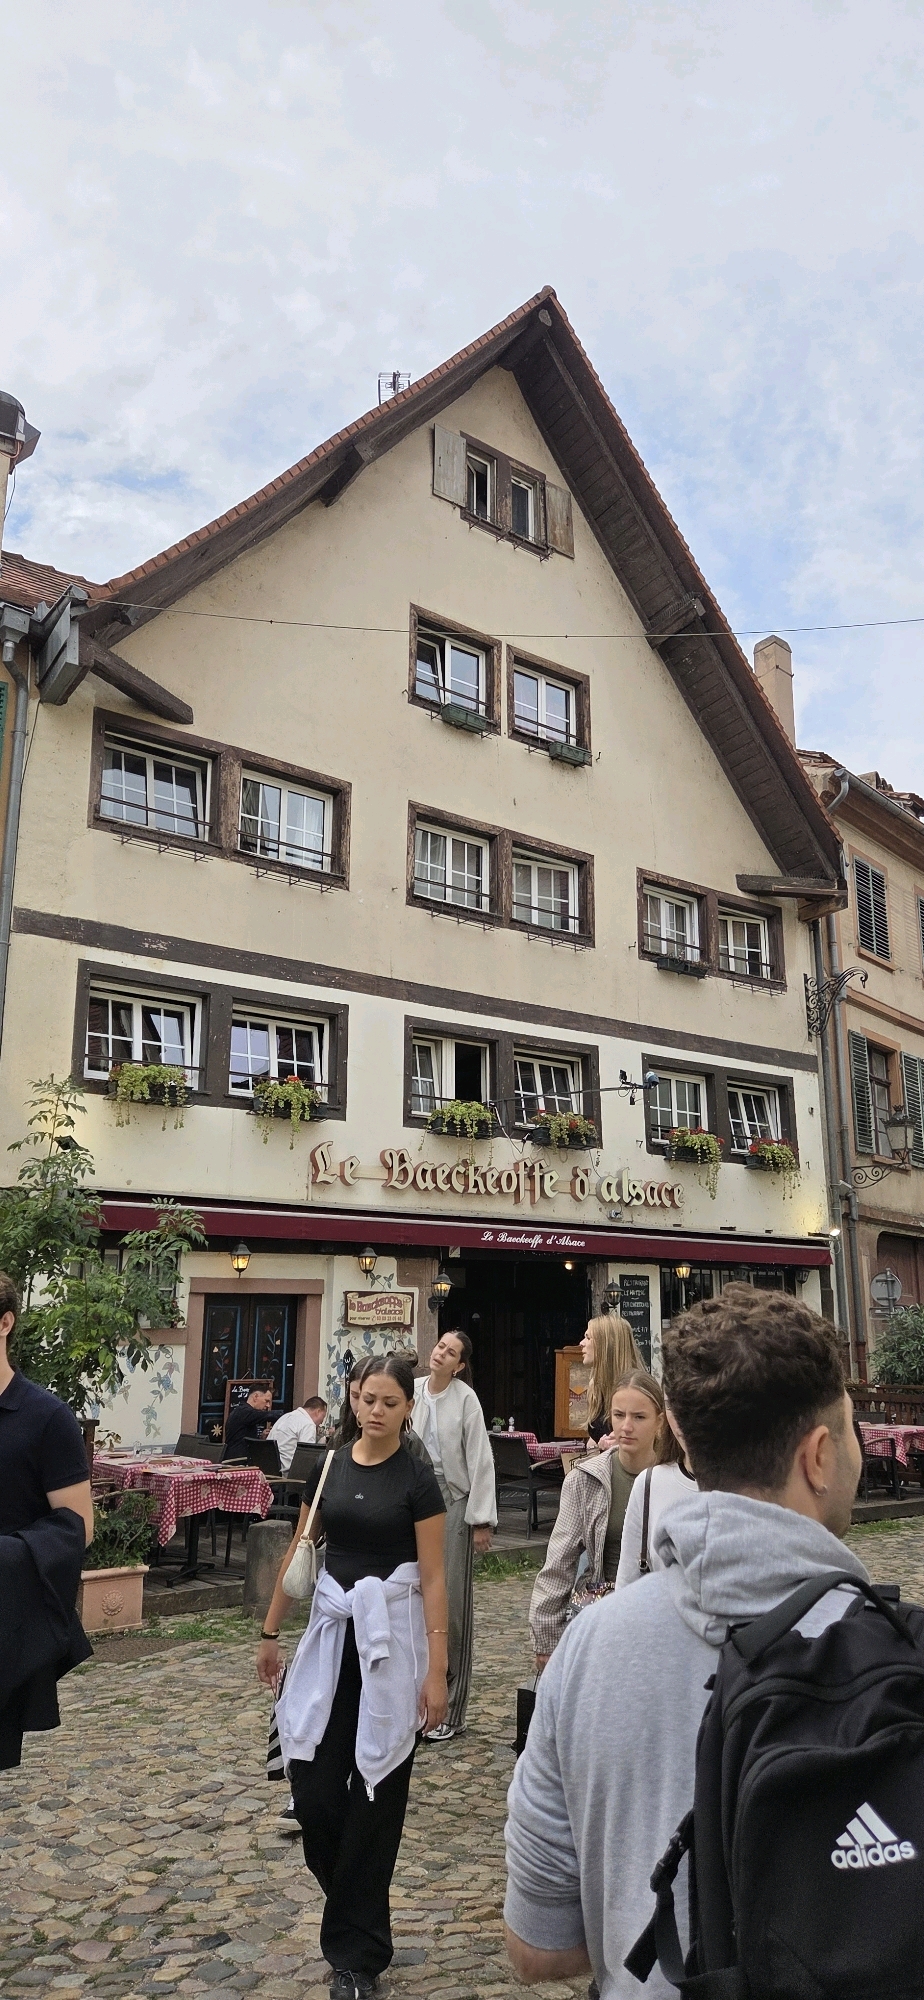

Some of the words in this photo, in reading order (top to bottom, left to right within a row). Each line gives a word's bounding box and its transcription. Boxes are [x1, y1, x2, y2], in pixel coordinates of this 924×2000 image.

[310, 1141, 360, 1186] Le
[380, 1148, 560, 1204] Baeckeoffe
[481, 1231, 494, 1242] Le
[497, 1232, 543, 1248] Baeckeoffe
[546, 1235, 586, 1247] d'Alsace
[831, 1841, 915, 1869] adidas
